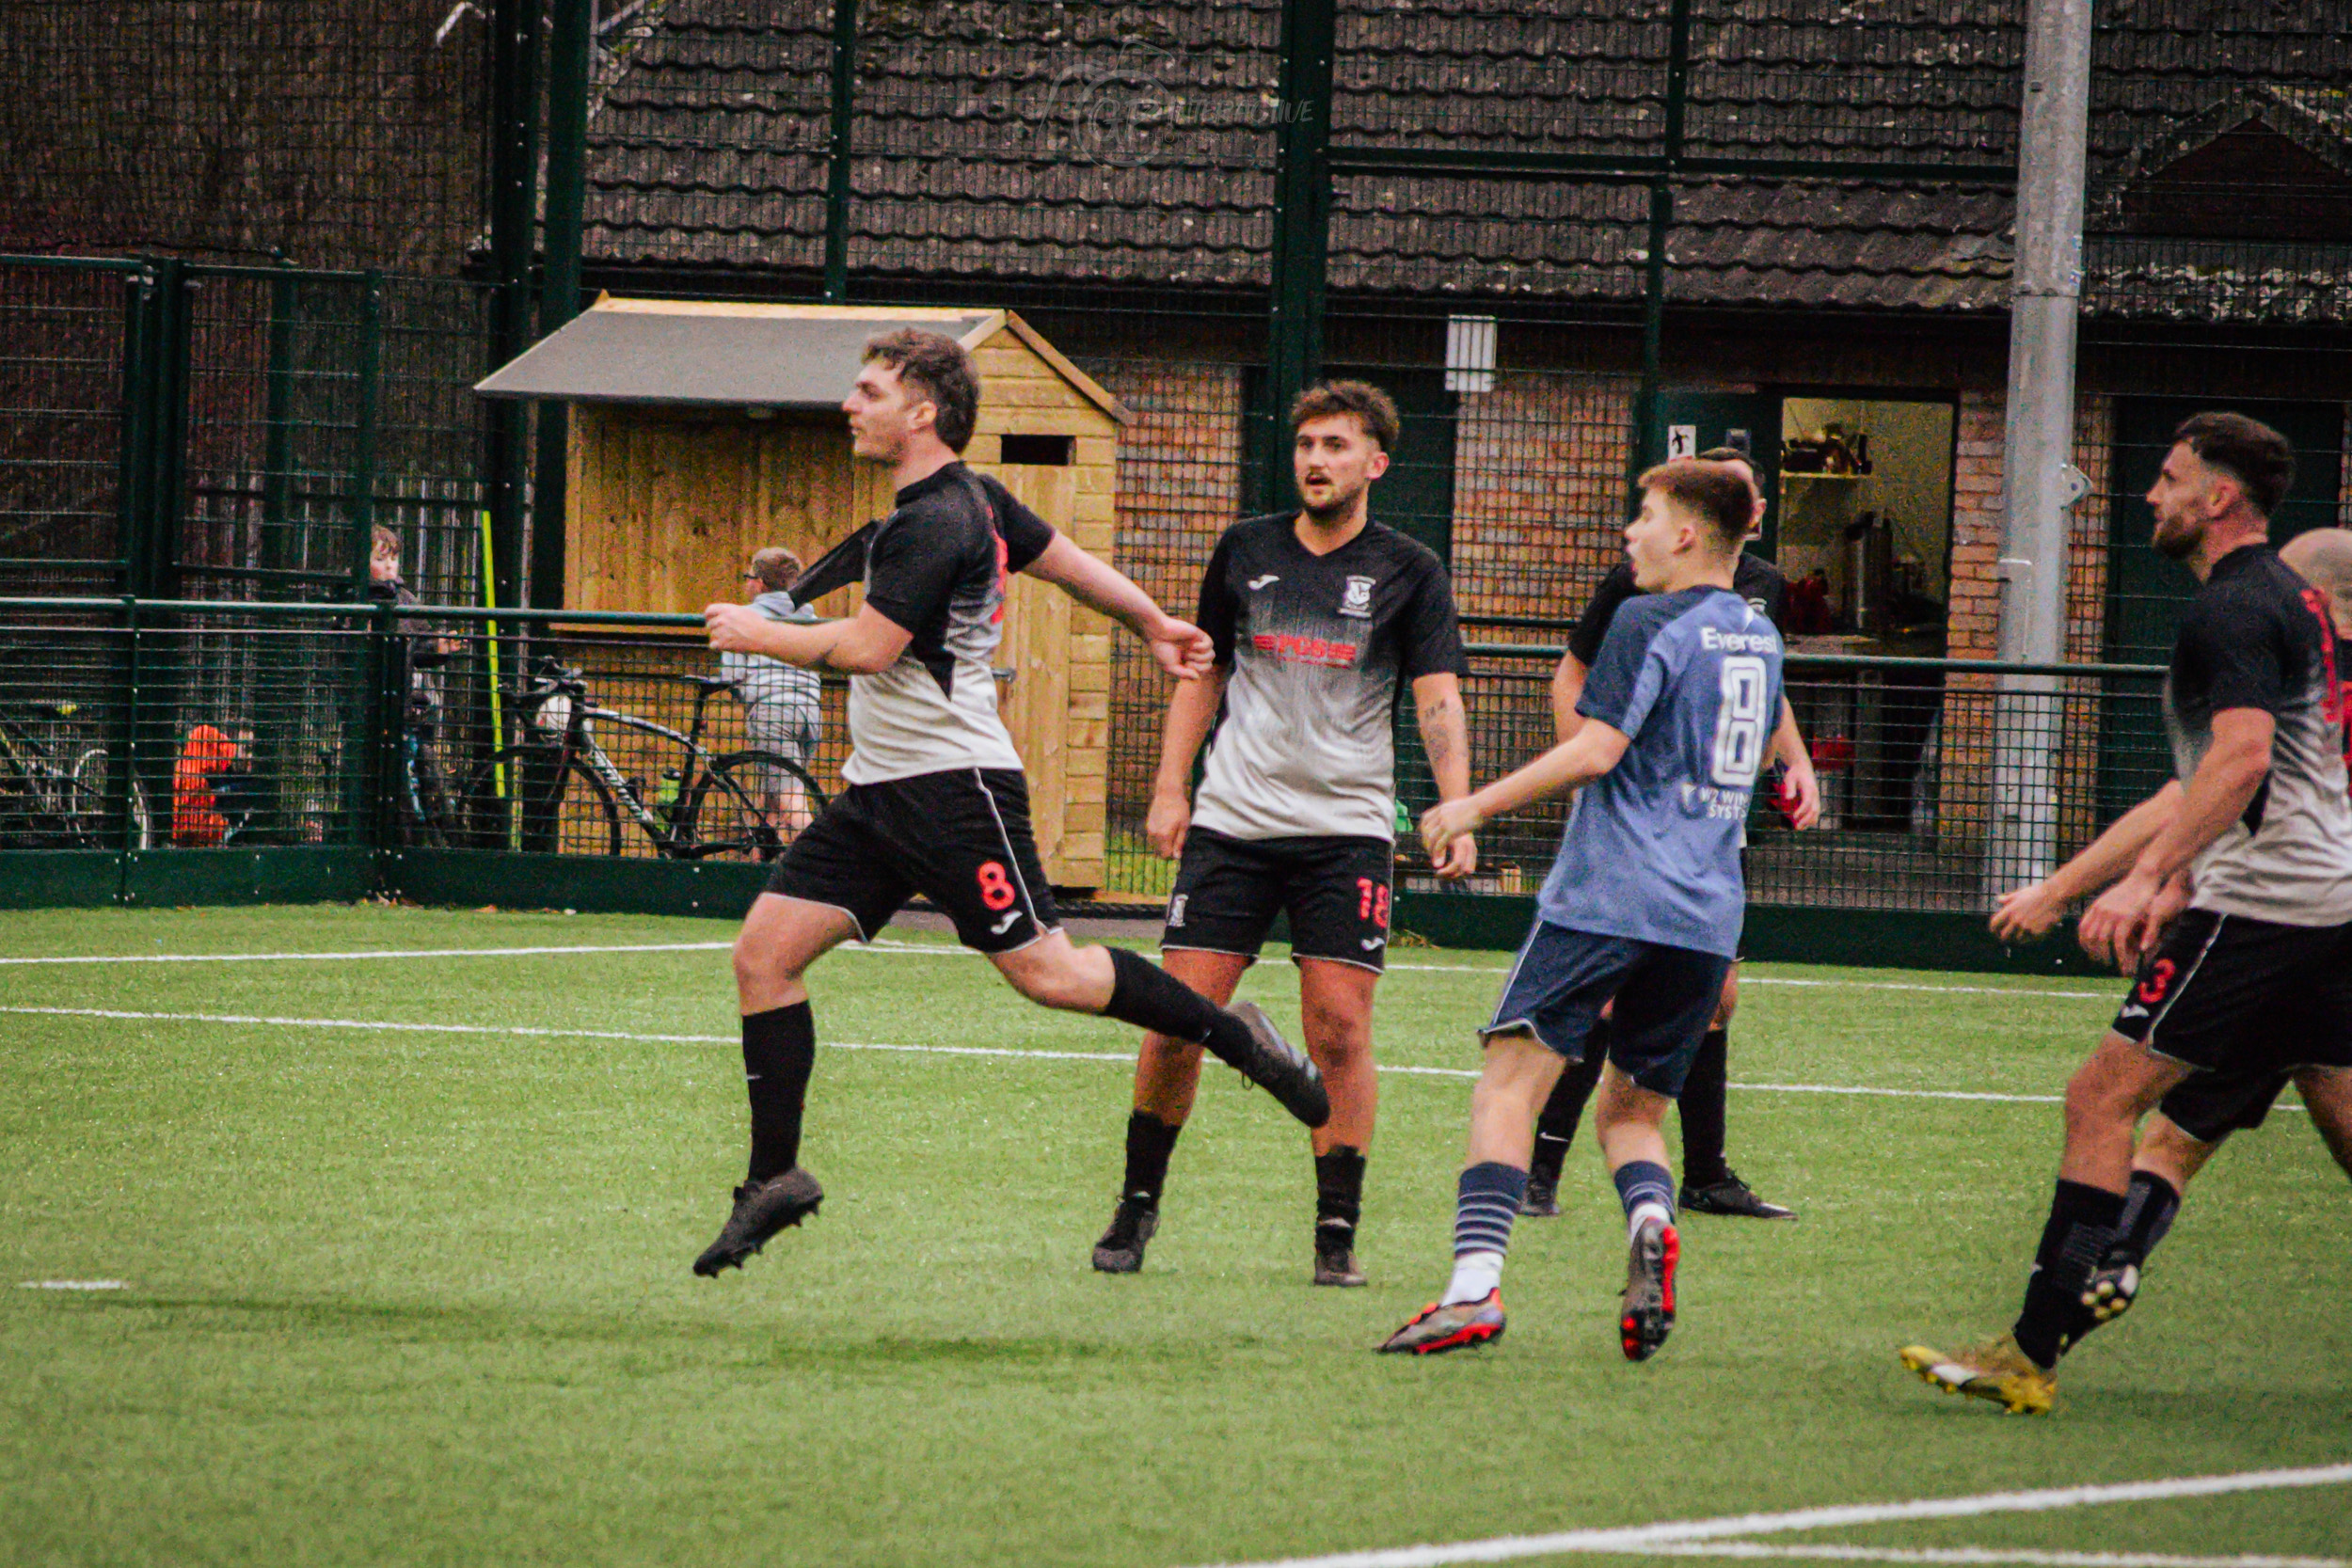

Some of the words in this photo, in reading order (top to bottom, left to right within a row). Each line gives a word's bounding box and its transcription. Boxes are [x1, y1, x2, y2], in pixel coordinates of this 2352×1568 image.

[1712, 657, 1768, 786] 8
[977, 860, 1016, 911] 8
[2138, 958, 2176, 1004] 3
